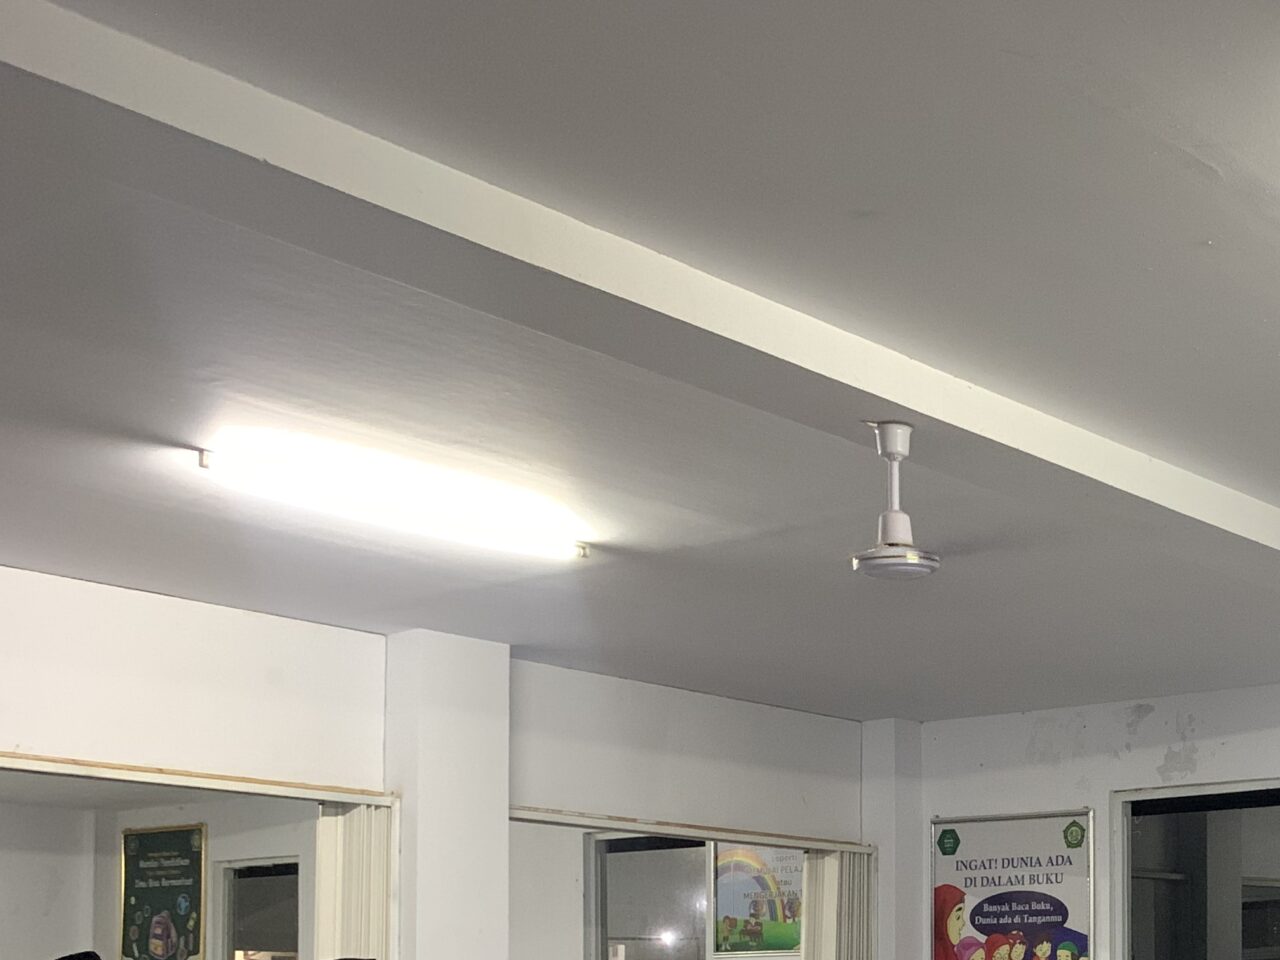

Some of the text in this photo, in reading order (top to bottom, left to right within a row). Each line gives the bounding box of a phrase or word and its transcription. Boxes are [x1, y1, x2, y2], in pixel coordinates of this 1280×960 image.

[780, 864, 803, 873] PELAJ
[955, 855, 1073, 872] INGAT! DUNIA ADA
[964, 872, 1064, 889] DI DALAM BUKU
[983, 903, 1010, 915] Banyak
[1011, 902, 1029, 912] Baca
[974, 914, 1063, 925] Dunia ada di Tanganmu
